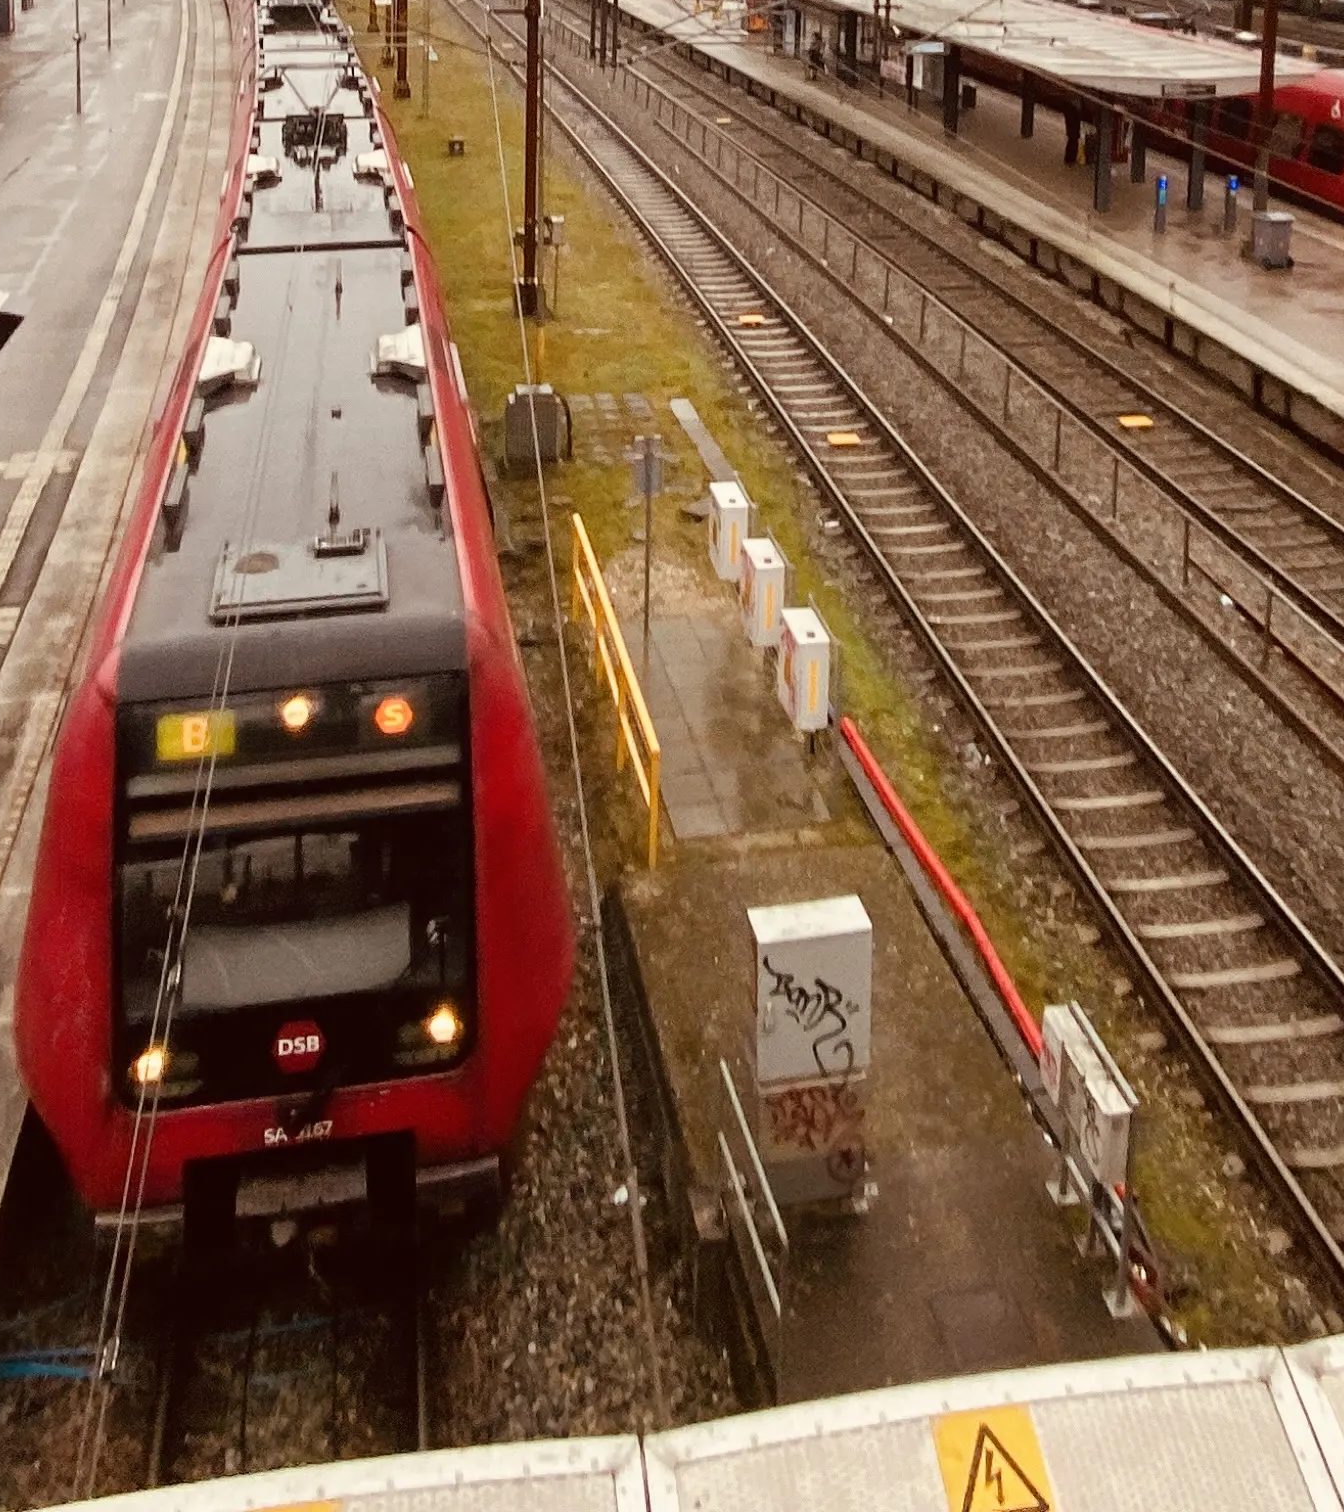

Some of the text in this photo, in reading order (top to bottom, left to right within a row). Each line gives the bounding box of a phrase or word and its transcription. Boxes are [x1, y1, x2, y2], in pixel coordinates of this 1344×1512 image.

[383, 703, 405, 726] S
[182, 715, 210, 753] B
[278, 1035, 320, 1056] DSB
[264, 1126, 288, 1143] SA
